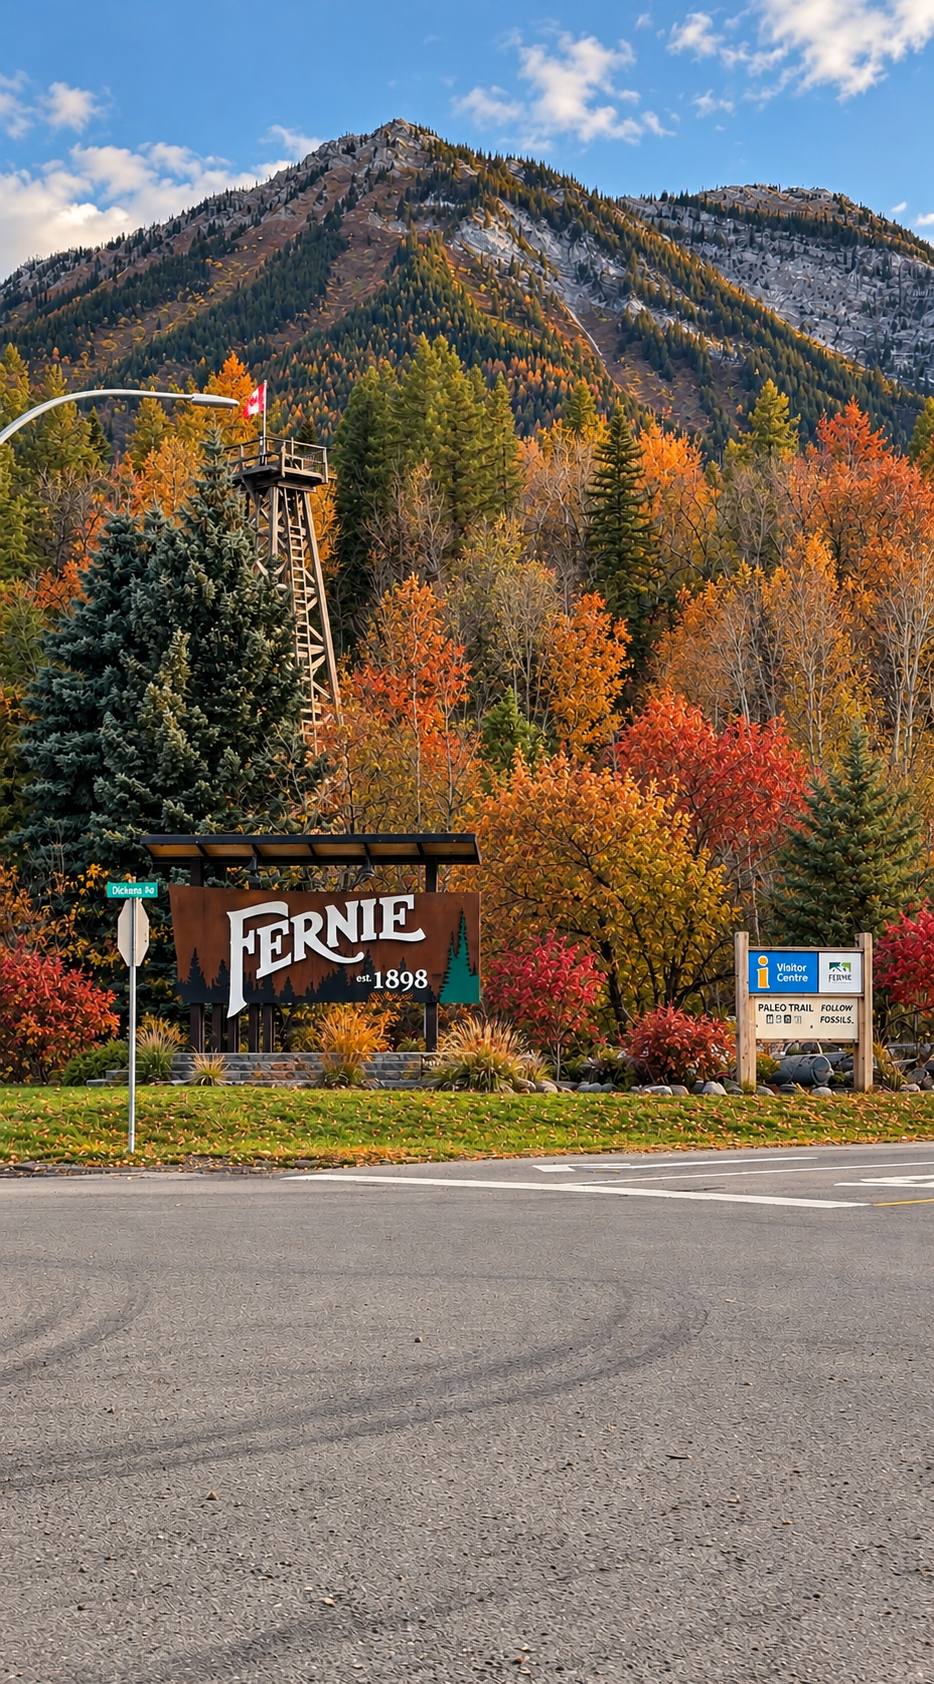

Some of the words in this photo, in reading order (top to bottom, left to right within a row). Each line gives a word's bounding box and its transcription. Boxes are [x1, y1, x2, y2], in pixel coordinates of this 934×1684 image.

[226, 894, 426, 1019] FERNIE
[776, 963, 807, 972] Visitor
[356, 974, 372, 984] est.
[373, 969, 428, 991] 1898
[776, 973, 808, 982] Centre
[758, 1003, 787, 1012] PALEO
[788, 1003, 814, 1012] TRAIL
[821, 1004, 853, 1012] FOLLOW
[820, 1016, 854, 1024] FOSSILS.
